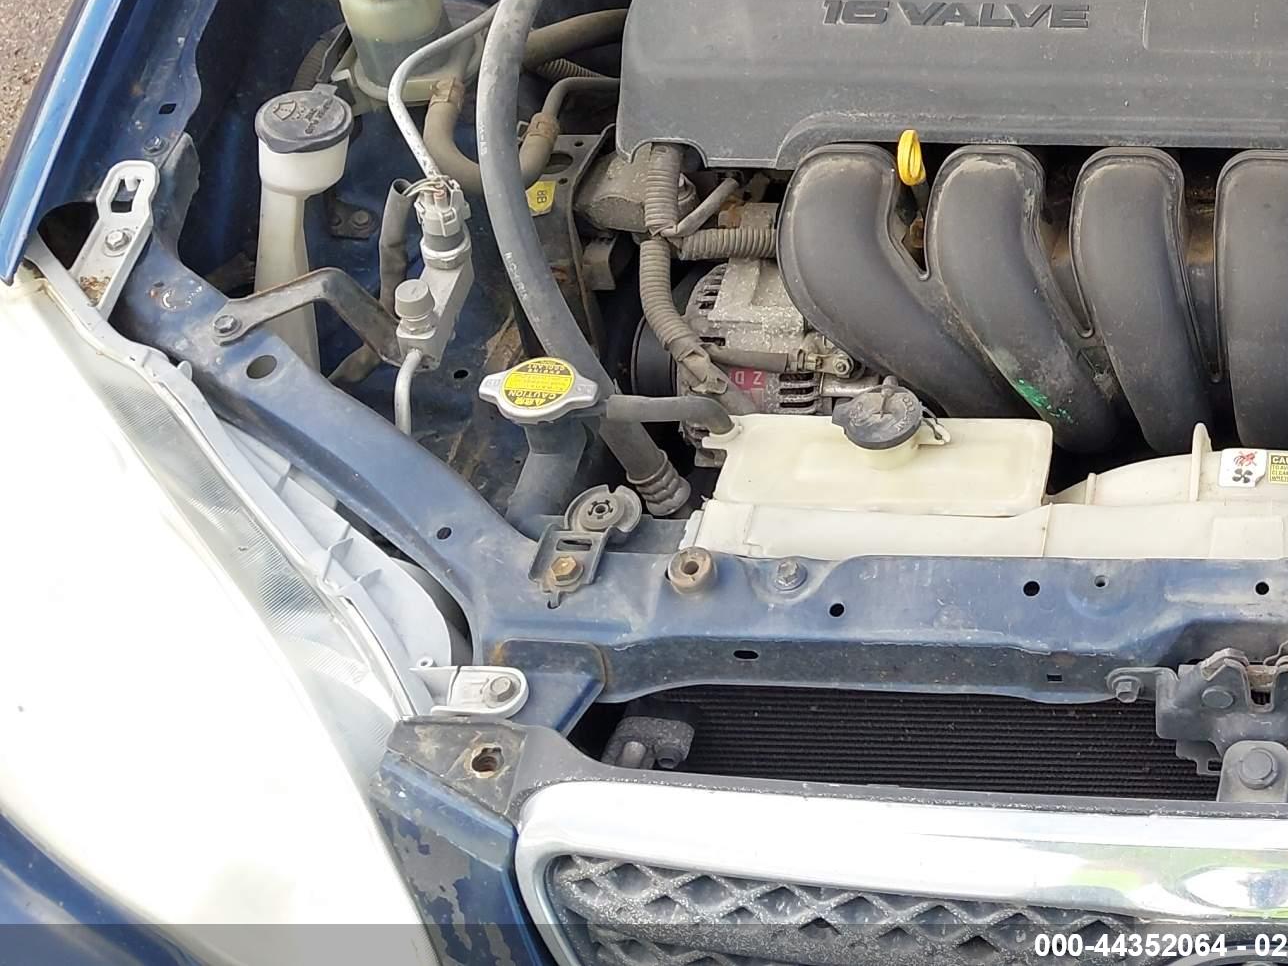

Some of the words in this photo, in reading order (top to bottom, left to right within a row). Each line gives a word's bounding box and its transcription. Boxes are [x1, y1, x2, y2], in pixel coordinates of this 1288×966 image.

[822, 0, 890, 26] 16
[897, 0, 1090, 29] VALVE
[507, 389, 557, 400] CAUTION
